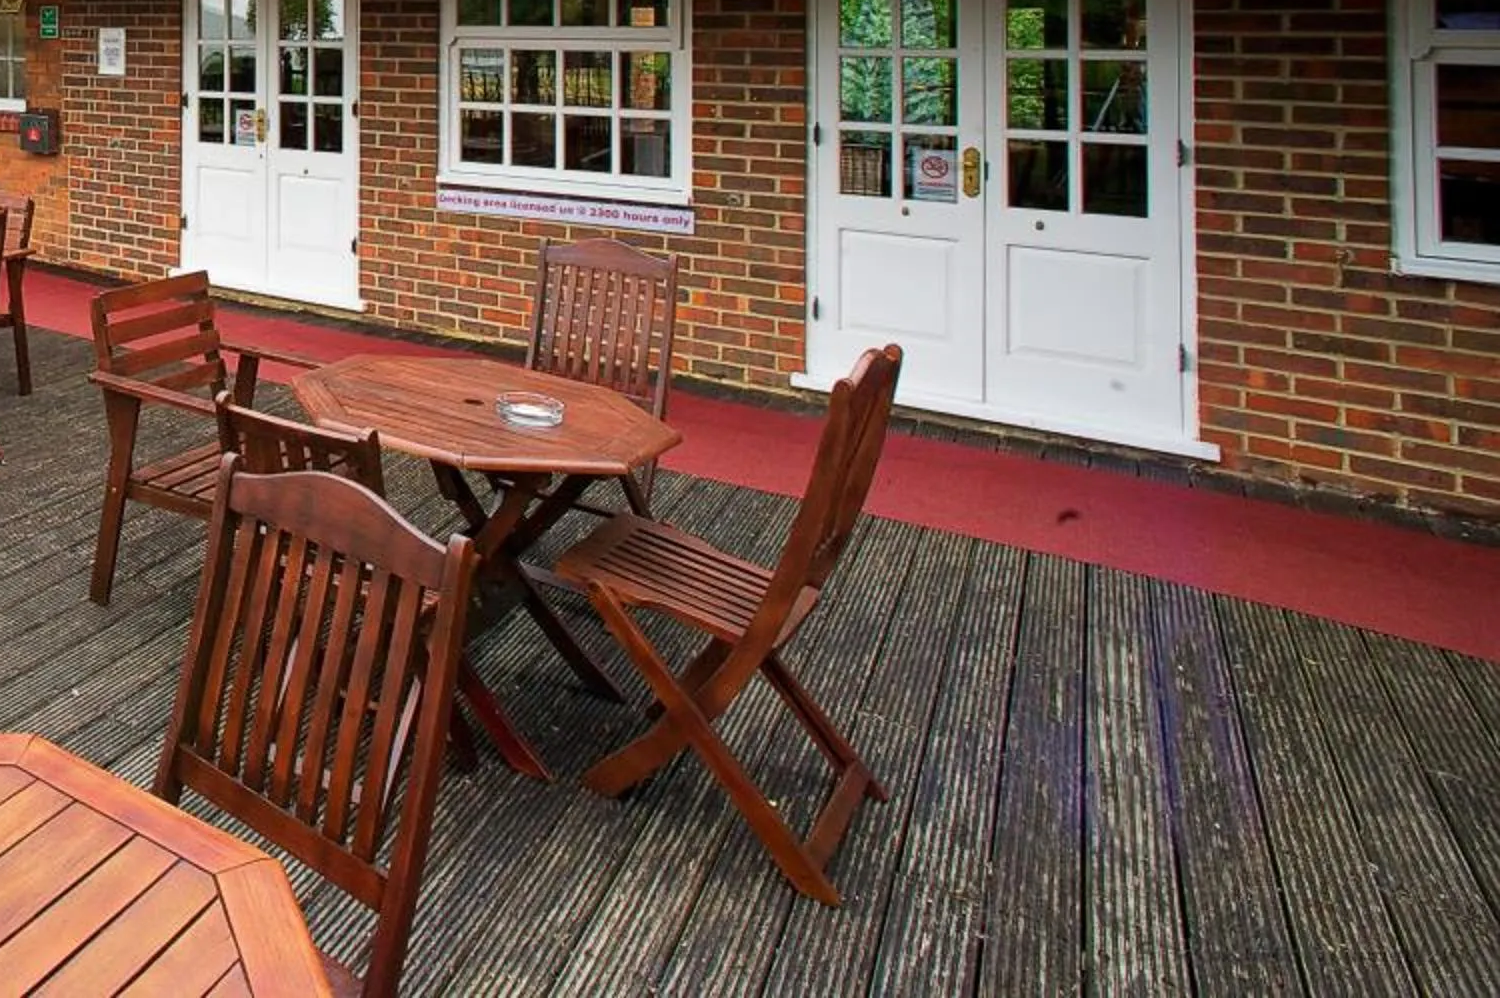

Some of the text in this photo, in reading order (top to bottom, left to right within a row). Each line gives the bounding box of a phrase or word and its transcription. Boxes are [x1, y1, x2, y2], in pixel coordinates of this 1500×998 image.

[483, 198, 507, 209] area
[623, 210, 659, 223] hours
[661, 214, 690, 228] only
